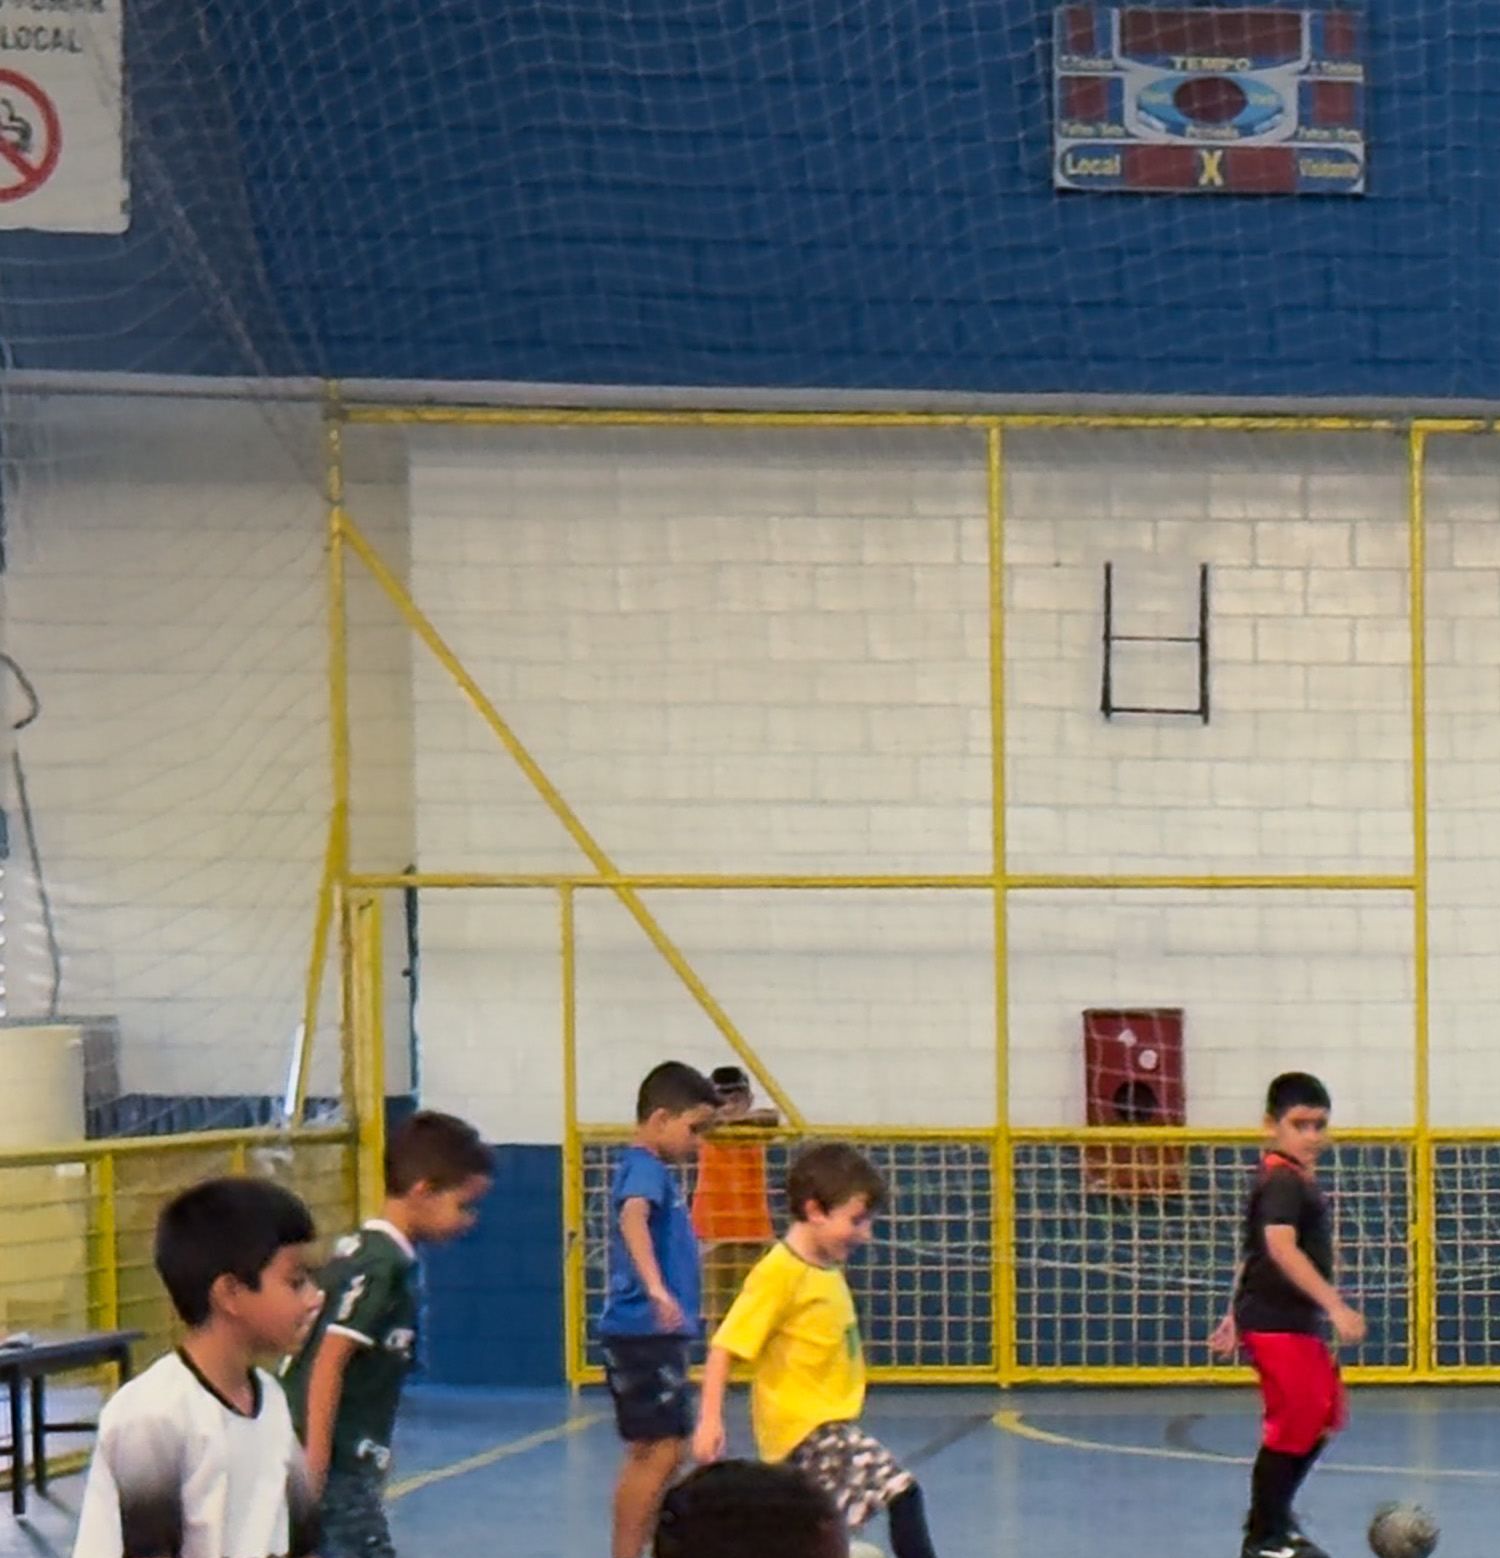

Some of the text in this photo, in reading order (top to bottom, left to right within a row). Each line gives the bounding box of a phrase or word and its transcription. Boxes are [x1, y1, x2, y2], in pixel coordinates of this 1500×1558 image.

[0, 25, 83, 54] LOCAL
[1169, 56, 1251, 72] TEMPO
[1065, 149, 1224, 187] Local X
